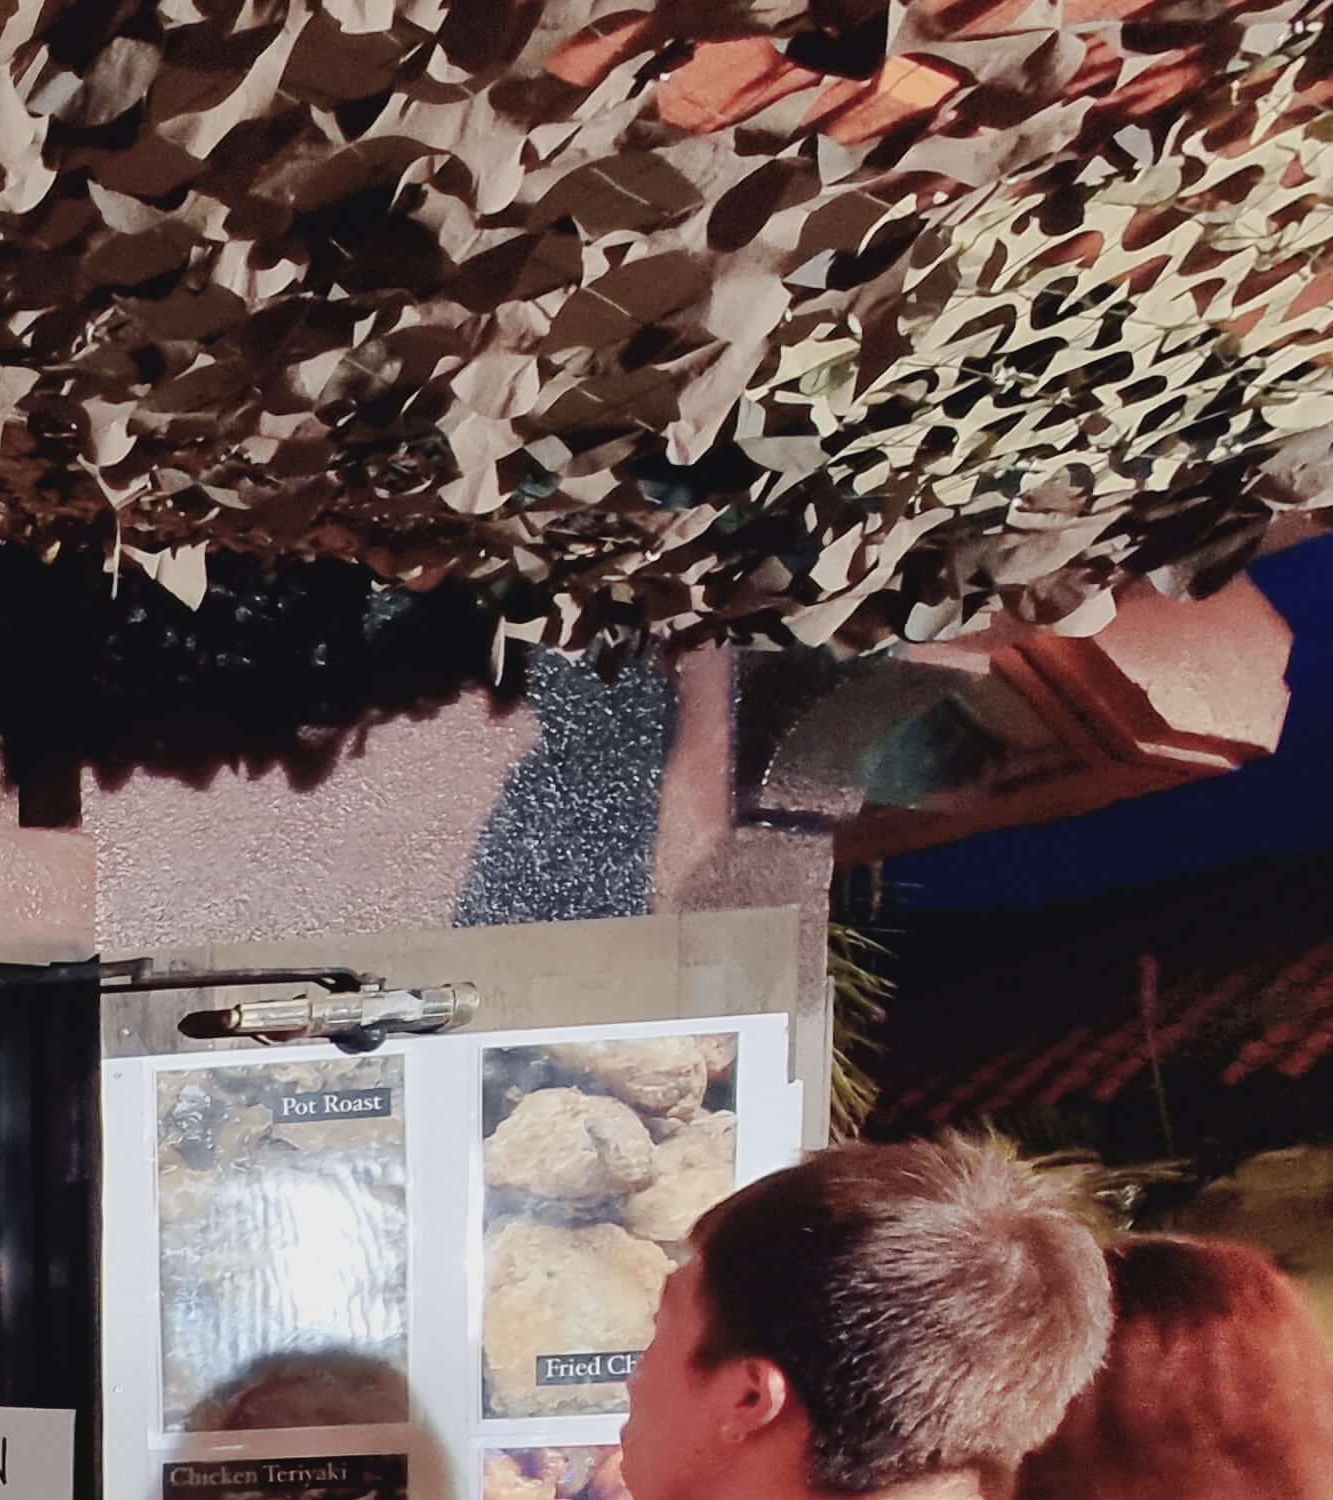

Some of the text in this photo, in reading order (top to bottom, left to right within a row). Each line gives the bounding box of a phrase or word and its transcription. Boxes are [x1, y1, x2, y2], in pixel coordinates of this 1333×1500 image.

[281, 1092, 383, 1116] Pot Roast
[546, 1356, 600, 1378] Fried
[170, 1461, 347, 1488] Chicken Teriyaki
